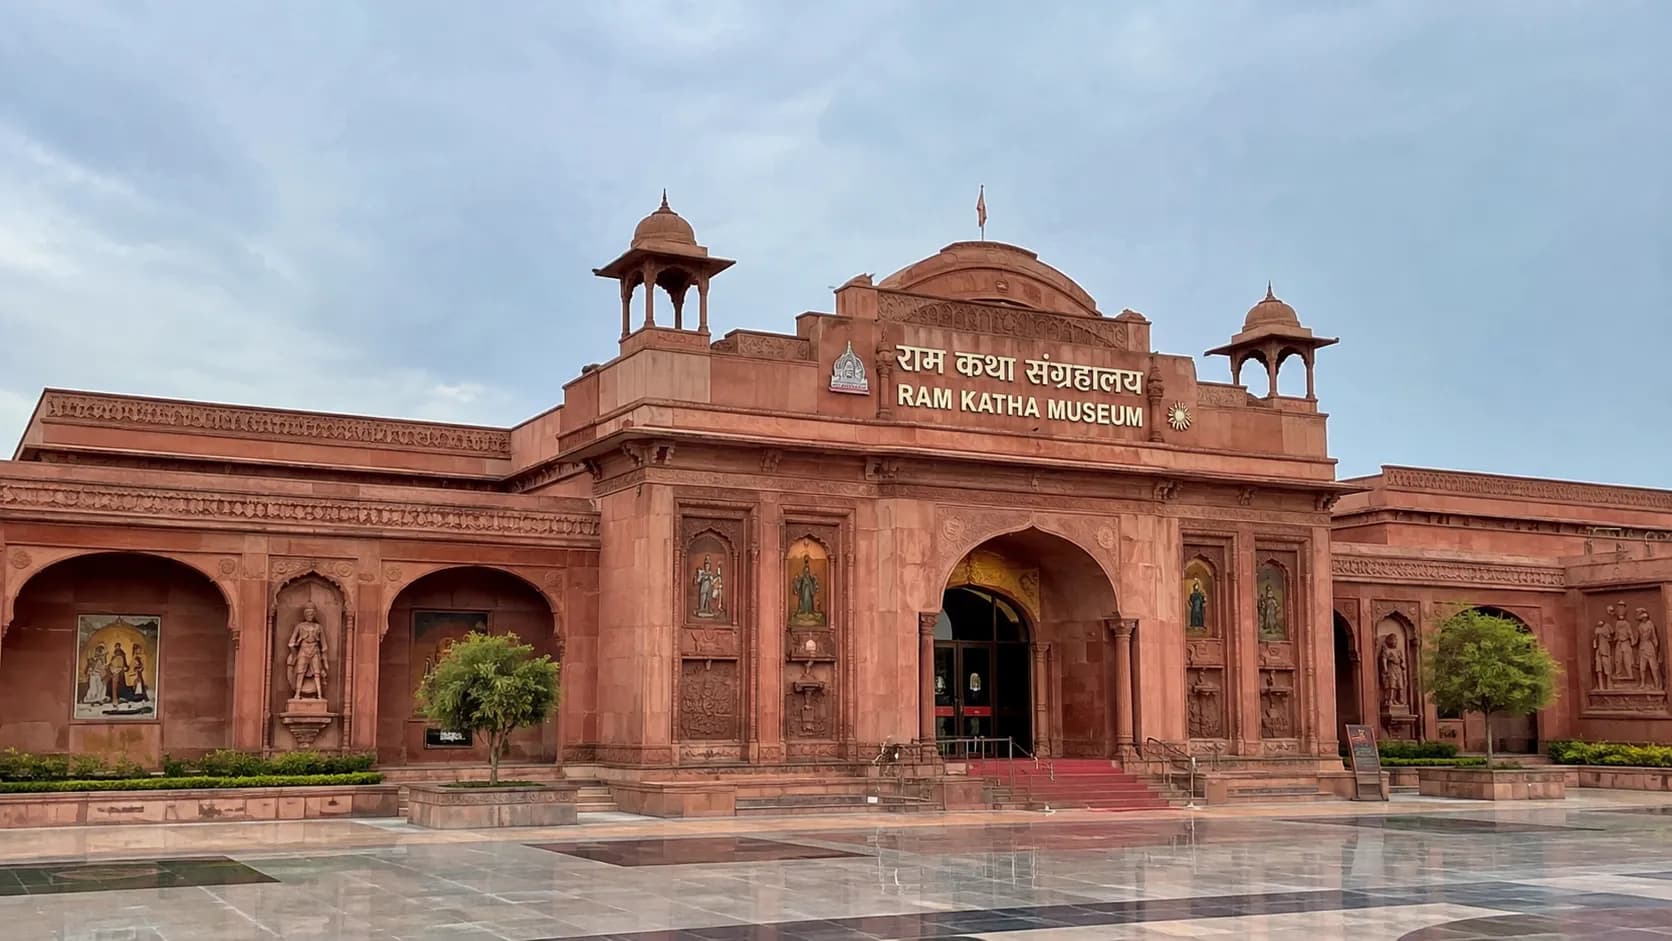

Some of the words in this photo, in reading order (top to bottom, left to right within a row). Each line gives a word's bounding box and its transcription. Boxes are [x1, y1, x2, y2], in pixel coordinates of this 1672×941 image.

[896, 344, 946, 374] राम
[954, 351, 1016, 382] कथा
[1025, 353, 1144, 395] संग्रहालय
[898, 384, 952, 410] RAM
[961, 390, 1040, 418] KATHA
[1047, 399, 1143, 428] MUSEUM
